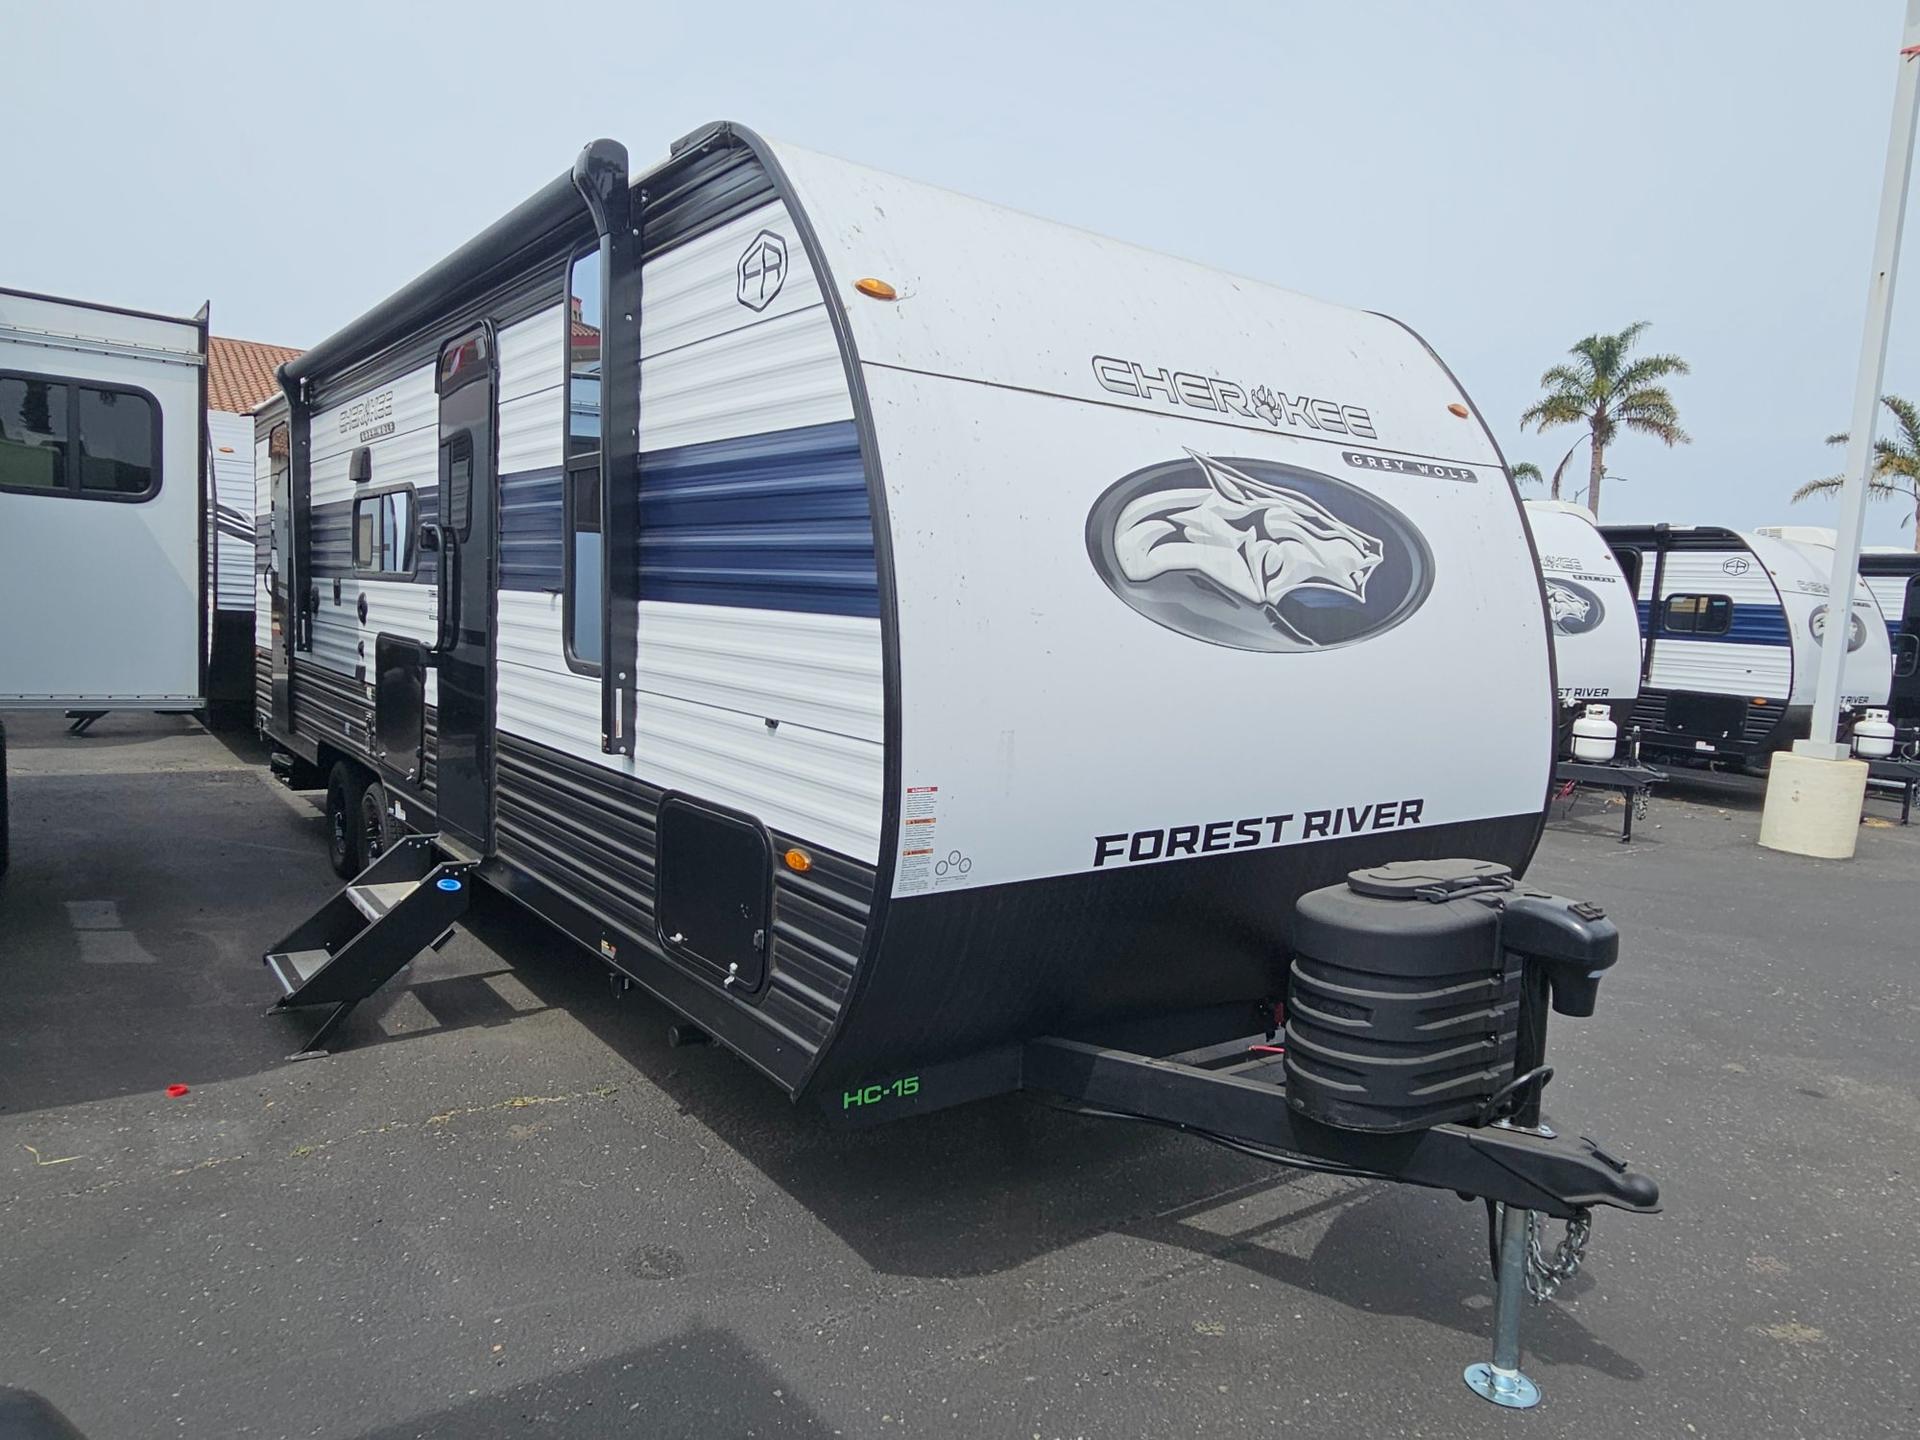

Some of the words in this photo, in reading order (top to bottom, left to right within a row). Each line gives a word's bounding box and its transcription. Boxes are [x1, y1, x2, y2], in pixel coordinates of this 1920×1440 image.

[1351, 455, 1404, 471] GREY
[1416, 464, 1469, 480] WOLF
[1573, 687, 1610, 697] RIVER
[1093, 814, 1294, 867] FOREST
[1302, 798, 1424, 840] RIVER
[843, 1076, 920, 1110] HC-15
